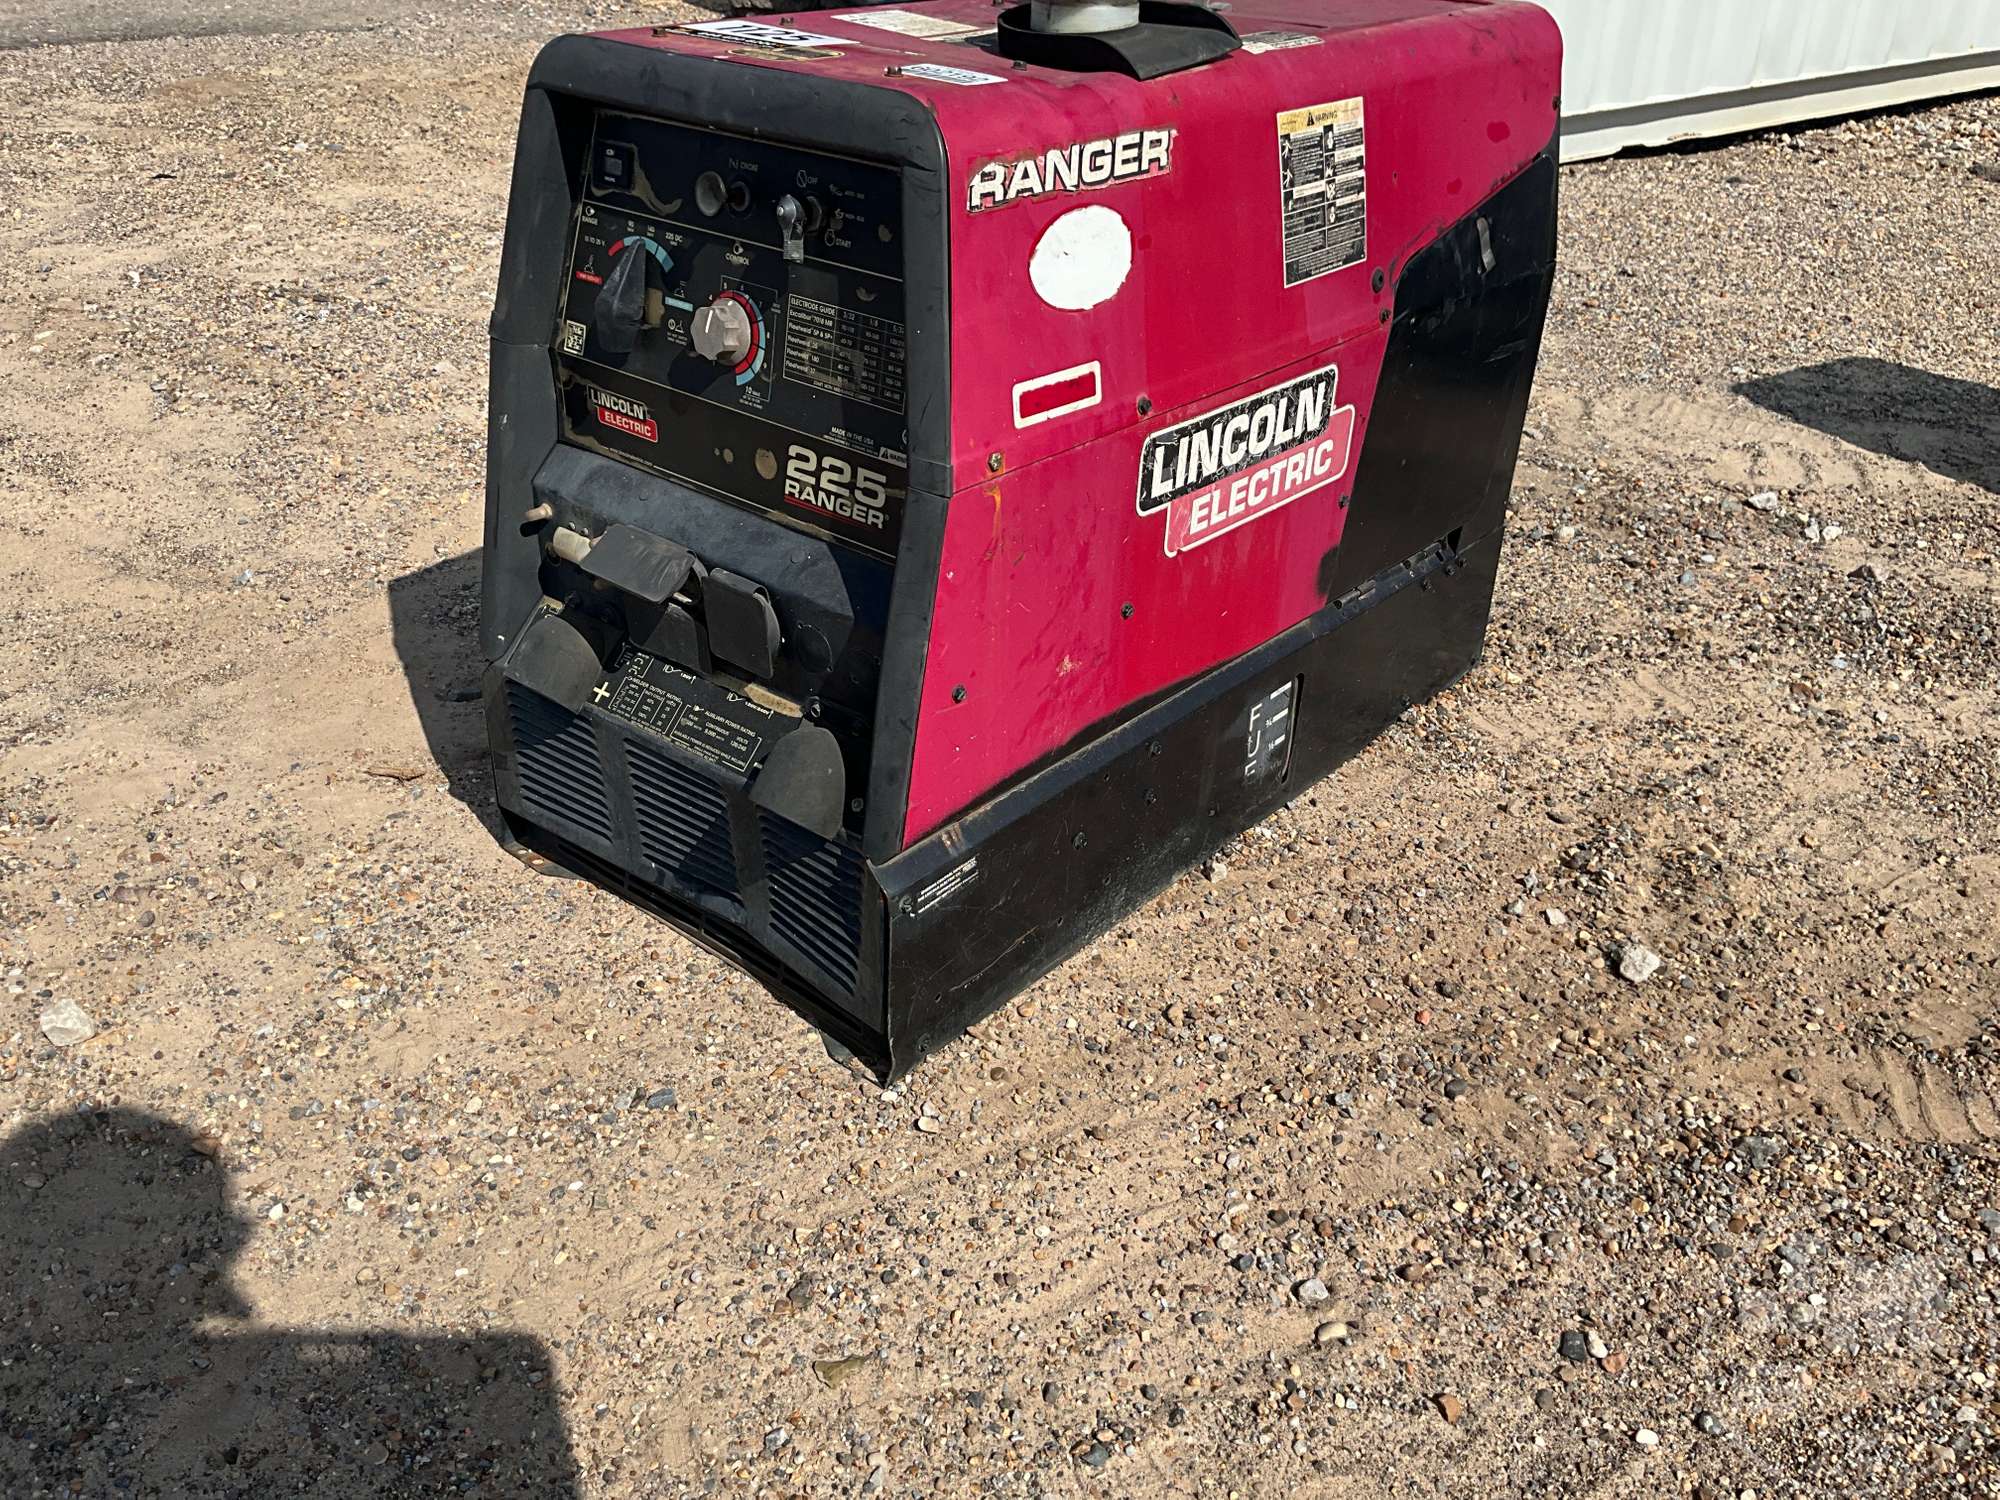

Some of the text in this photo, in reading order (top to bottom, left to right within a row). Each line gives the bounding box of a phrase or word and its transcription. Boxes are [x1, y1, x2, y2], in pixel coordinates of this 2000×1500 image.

[968, 130, 1171, 211] RANGER
[582, 216, 598, 225] RANGE
[725, 254, 750, 265] CONTROL
[791, 297, 819, 311] ELECTRODE
[819, 305, 836, 316] GUIDE
[590, 388, 645, 420] LINCOLN
[604, 411, 652, 437] ELECTRIC
[1150, 381, 1327, 499] LINCOLN
[786, 444, 887, 508] 225
[1190, 439, 1334, 536] ELECTRIC
[784, 479, 884, 529] RANGER
[649, 686, 665, 696] OUTPUT
